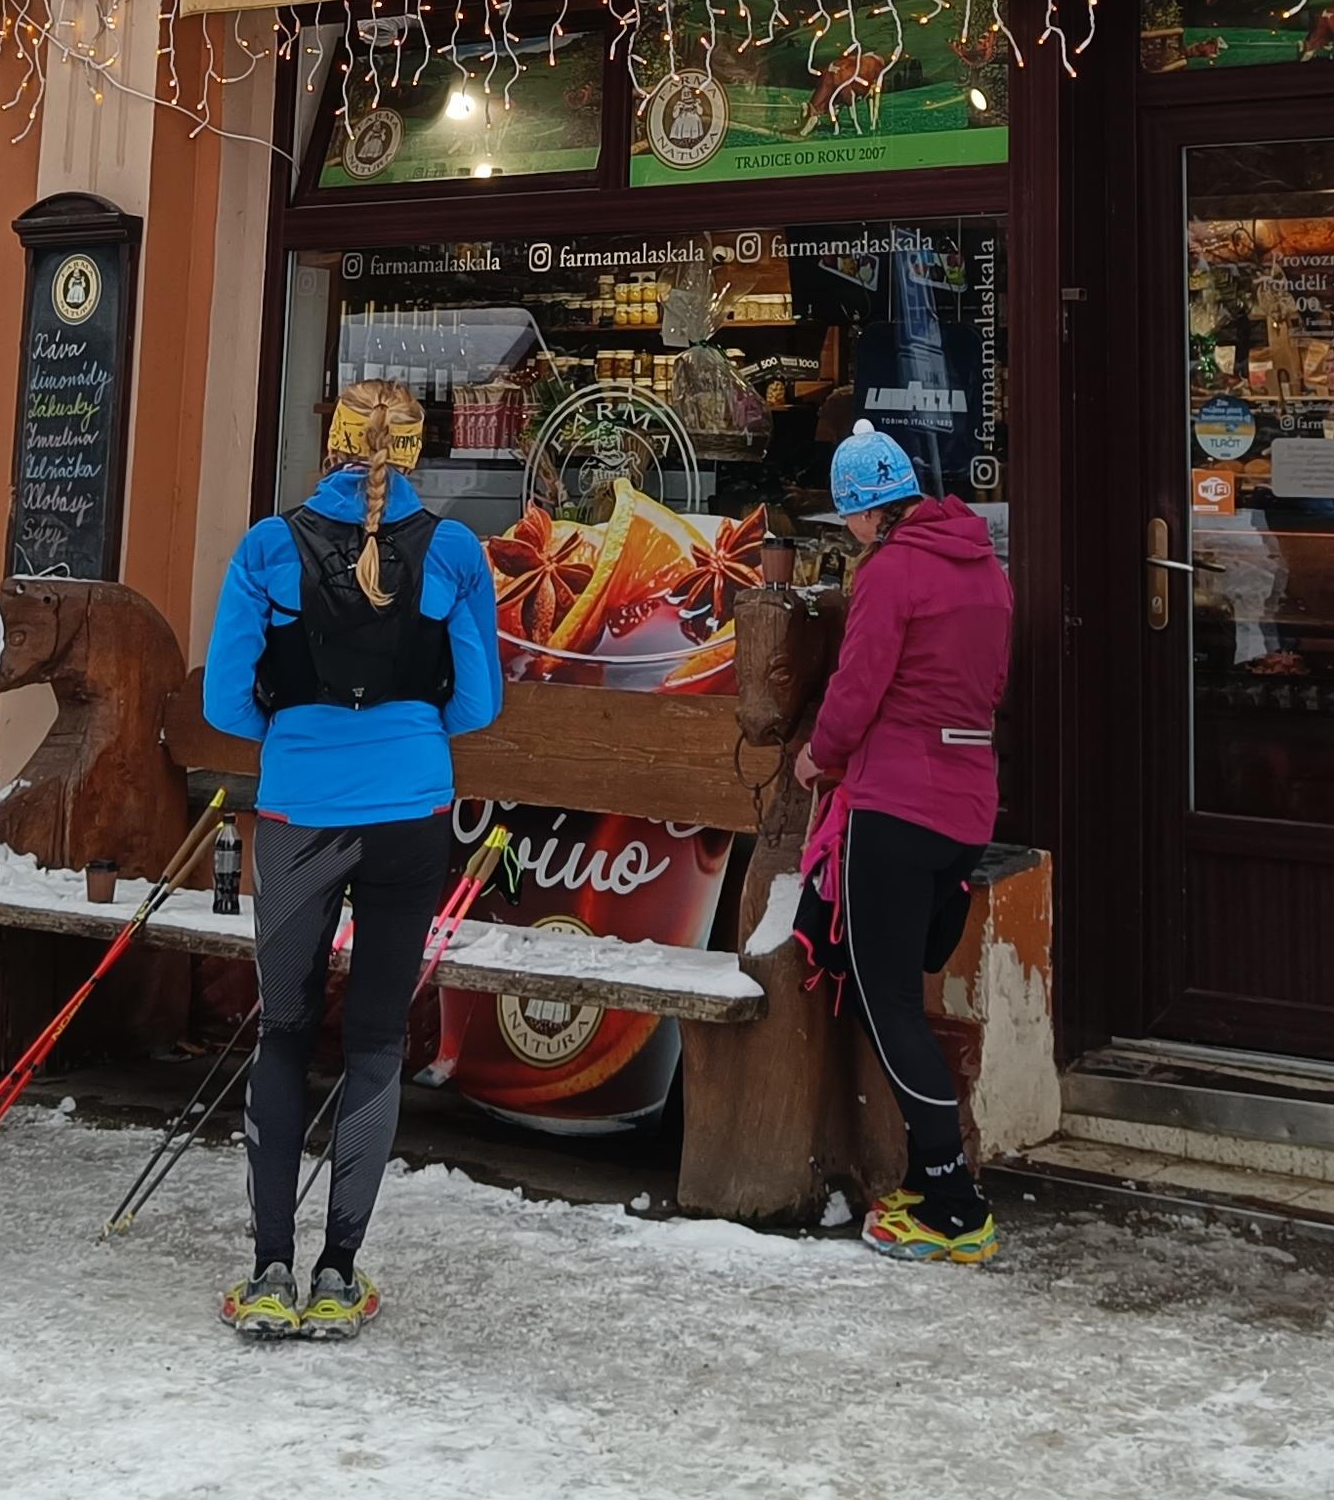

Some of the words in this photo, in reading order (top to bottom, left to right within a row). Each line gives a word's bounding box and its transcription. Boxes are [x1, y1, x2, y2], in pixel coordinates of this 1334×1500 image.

[657, 132, 718, 161] NATURA
[735, 152, 791, 169] TRADICE
[795, 152, 816, 165] OD
[818, 149, 856, 164] ROKU
[858, 146, 887, 160] 2007
[559, 240, 705, 268] farmamalaskala
[771, 229, 933, 258] farmamalaskala
[370, 251, 501, 276] farmamalaskala
[33, 330, 87, 360] Káva
[974, 238, 996, 444] farmamalaskala
[761, 356, 778, 369] 500
[798, 359, 819, 369] 1000
[30, 361, 113, 404] Limonády
[28, 392, 100, 433] Zákusky
[26, 422, 99, 450] Zmrzlina
[550, 403, 671, 457] FARMA
[23, 482, 94, 527] Klobásy
[22, 518, 67, 558] Sýry
[507, 1009, 591, 1056] NATURA
